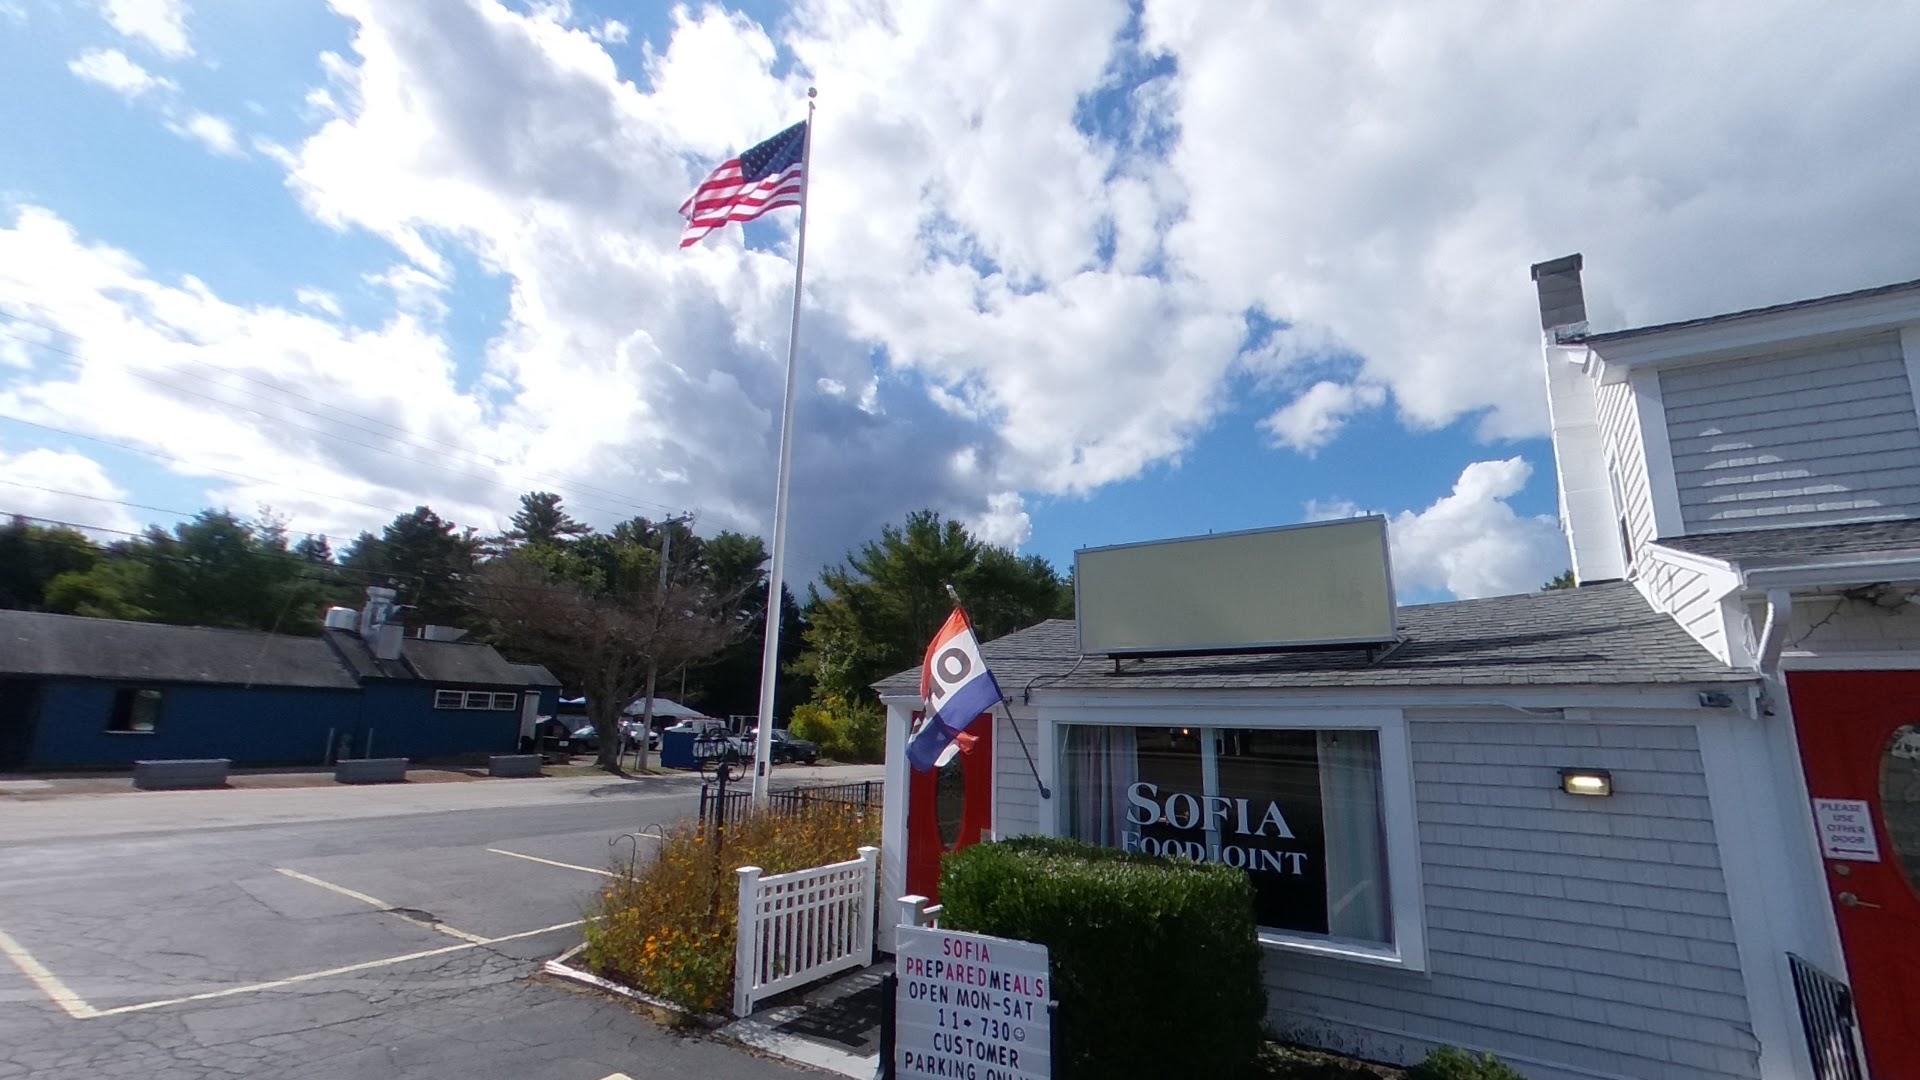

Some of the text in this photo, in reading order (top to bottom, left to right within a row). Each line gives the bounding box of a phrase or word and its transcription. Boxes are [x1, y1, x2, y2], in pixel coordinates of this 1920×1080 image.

[1126, 782, 1295, 839] SOFIA
[1821, 803, 1861, 812] PLEASE
[943, 938, 990, 963] SOFIA
[909, 981, 1033, 1021] OPEN MON-SAT
[981, 1017, 1010, 1041] 730
[933, 1032, 1019, 1069] CUSTOMER
[904, 1052, 976, 1080] PARKING
